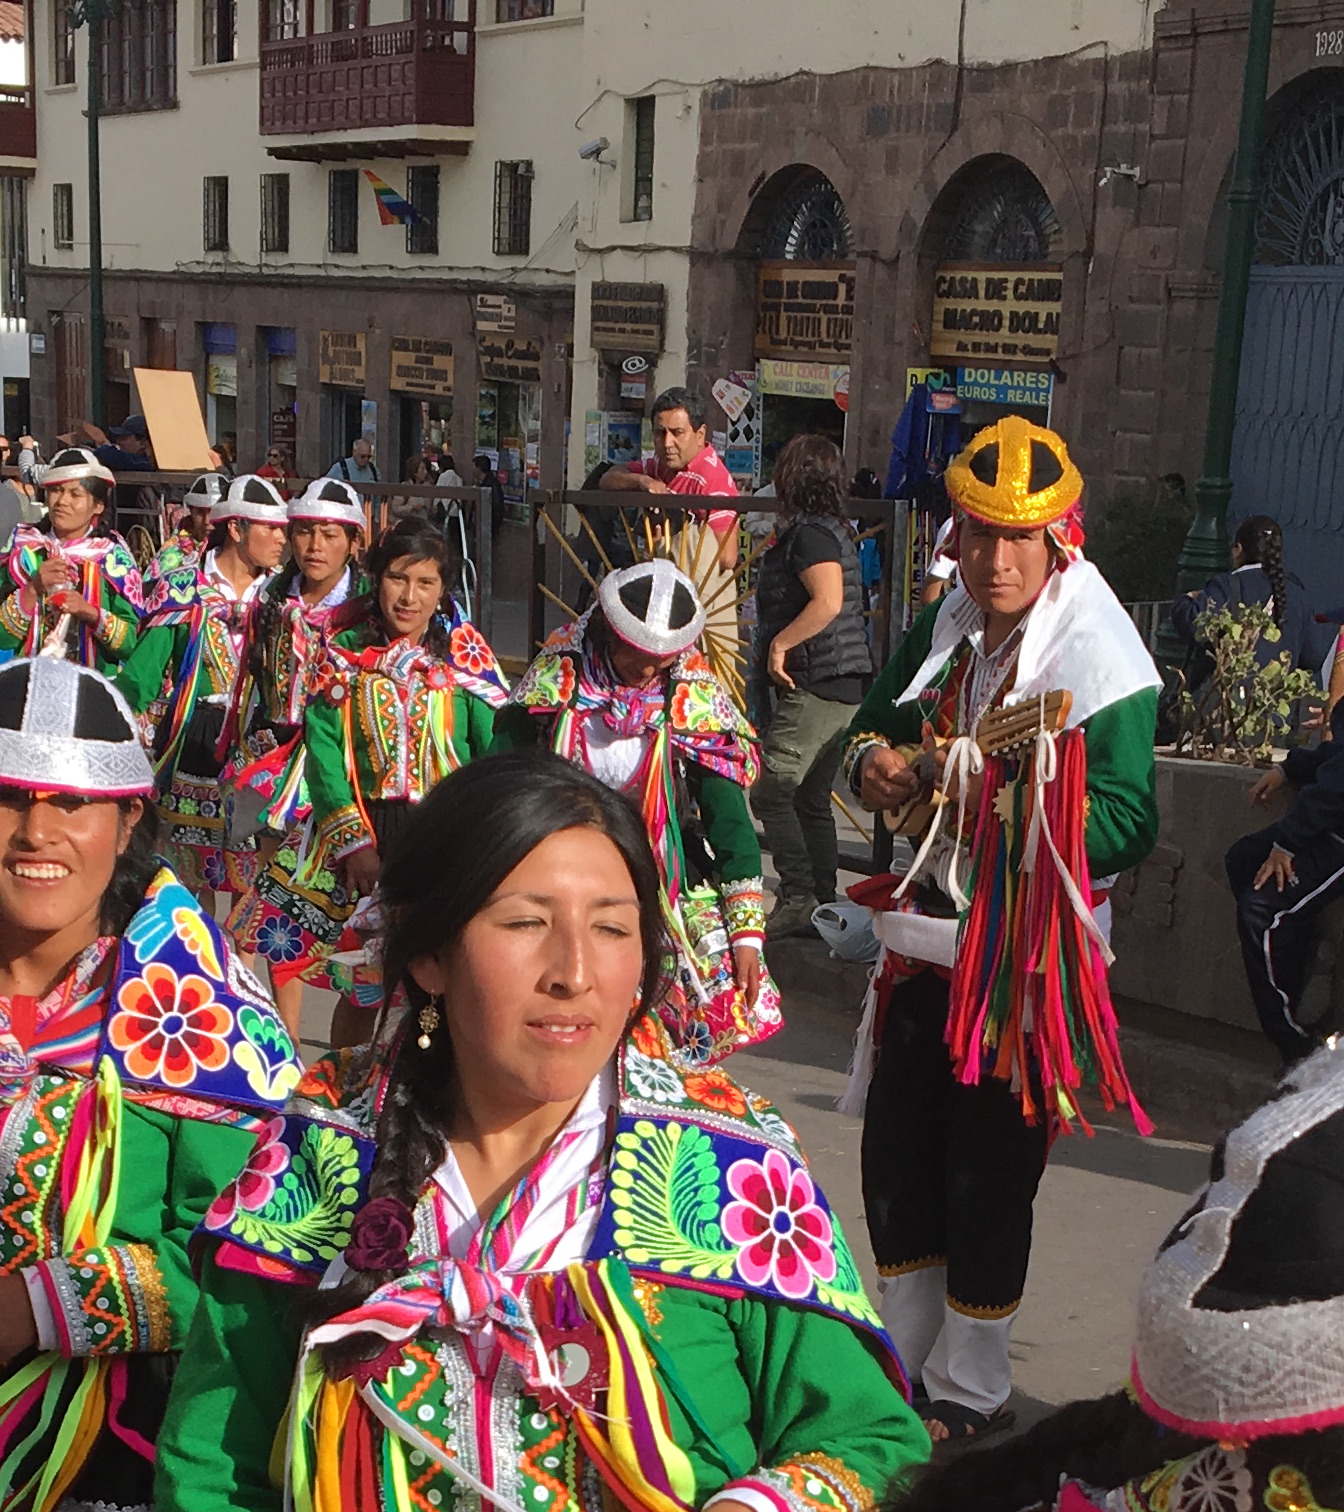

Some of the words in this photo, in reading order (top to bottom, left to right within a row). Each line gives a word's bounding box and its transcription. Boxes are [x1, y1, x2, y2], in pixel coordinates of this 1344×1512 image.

[1315, 30, 1344, 57] 1928
[936, 275, 979, 301] CASA
[984, 277, 1009, 302] DE
[964, 367, 1049, 389] DOLARES
[957, 385, 997, 400] EUROS
